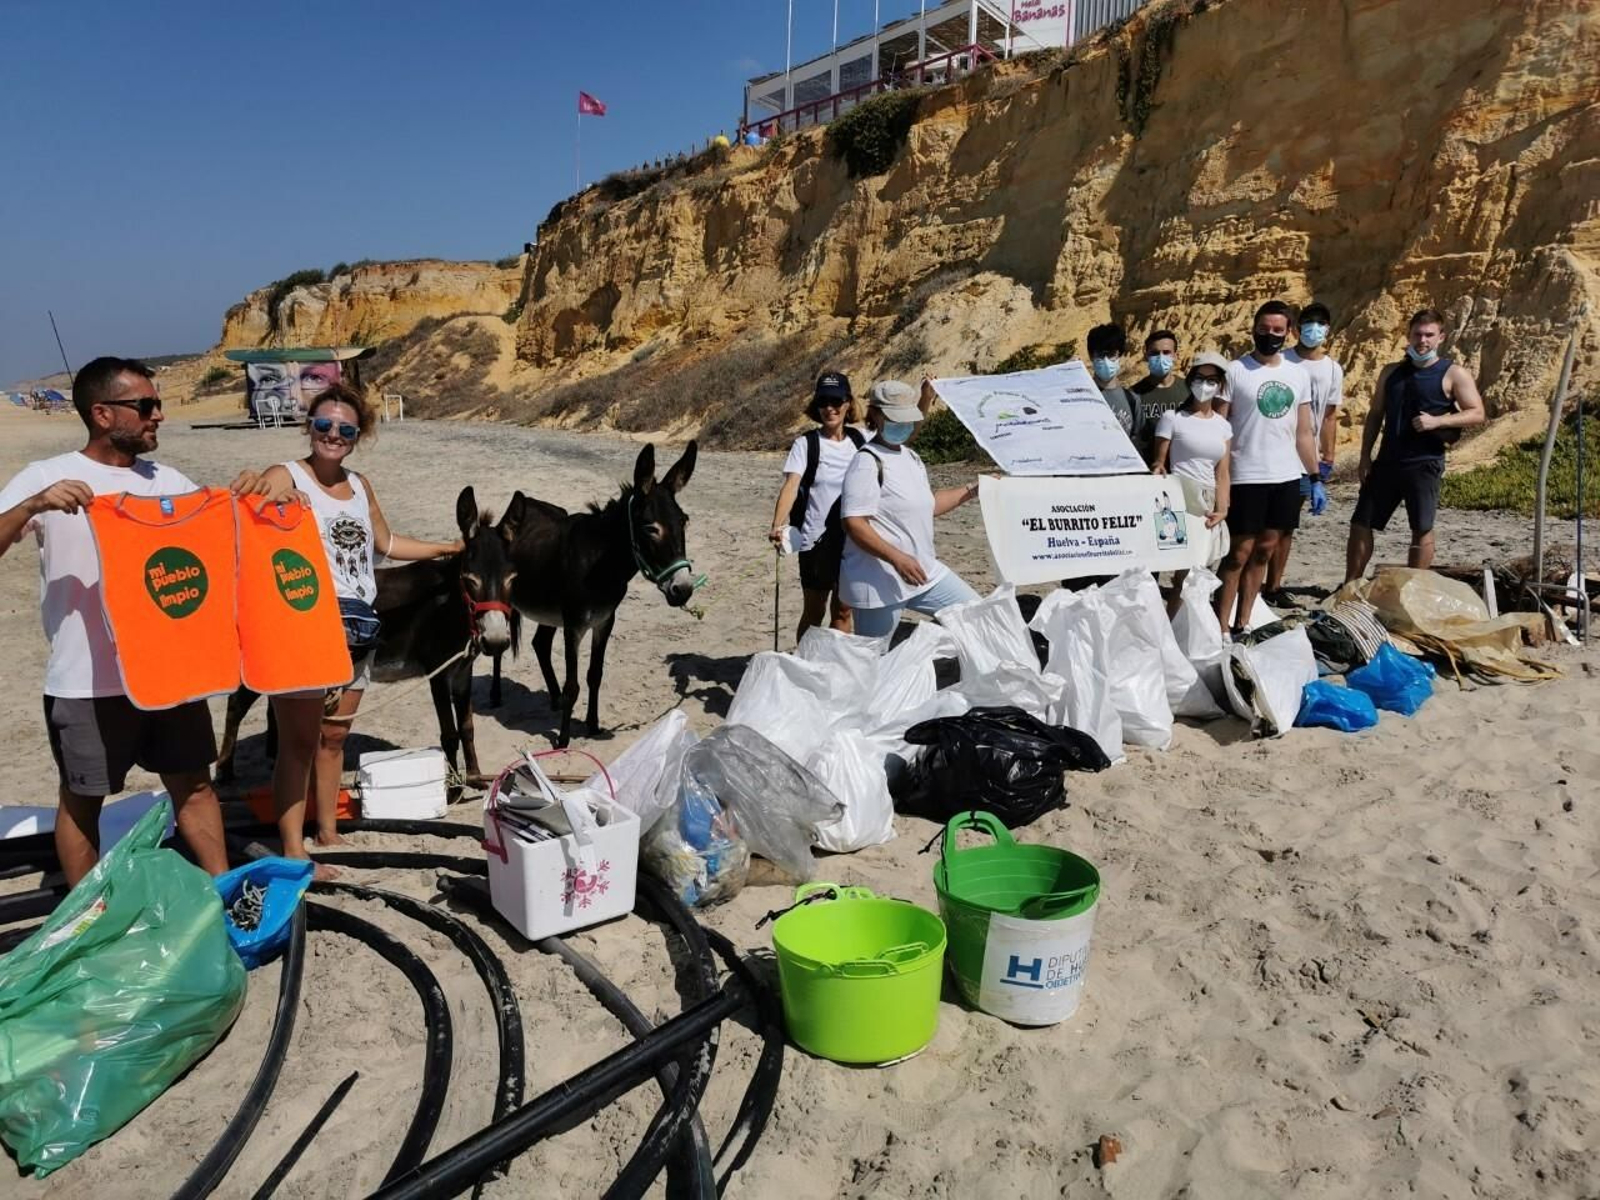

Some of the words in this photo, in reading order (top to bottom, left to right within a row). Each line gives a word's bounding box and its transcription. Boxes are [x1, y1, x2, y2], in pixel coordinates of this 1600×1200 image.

[1014, 4, 1065, 22] Bananas
[1051, 504, 1096, 513] ASOCIACIÓN
[1048, 517, 1099, 531] BURRITO
[1047, 537, 1079, 548] Huelva
[1087, 535, 1120, 548] España
[148, 562, 166, 579] mi
[280, 566, 312, 585] pueblo
[152, 566, 200, 592] pueblo
[160, 586, 200, 608] limpio
[285, 585, 315, 601] limpio
[1046, 968, 1063, 981] DE
